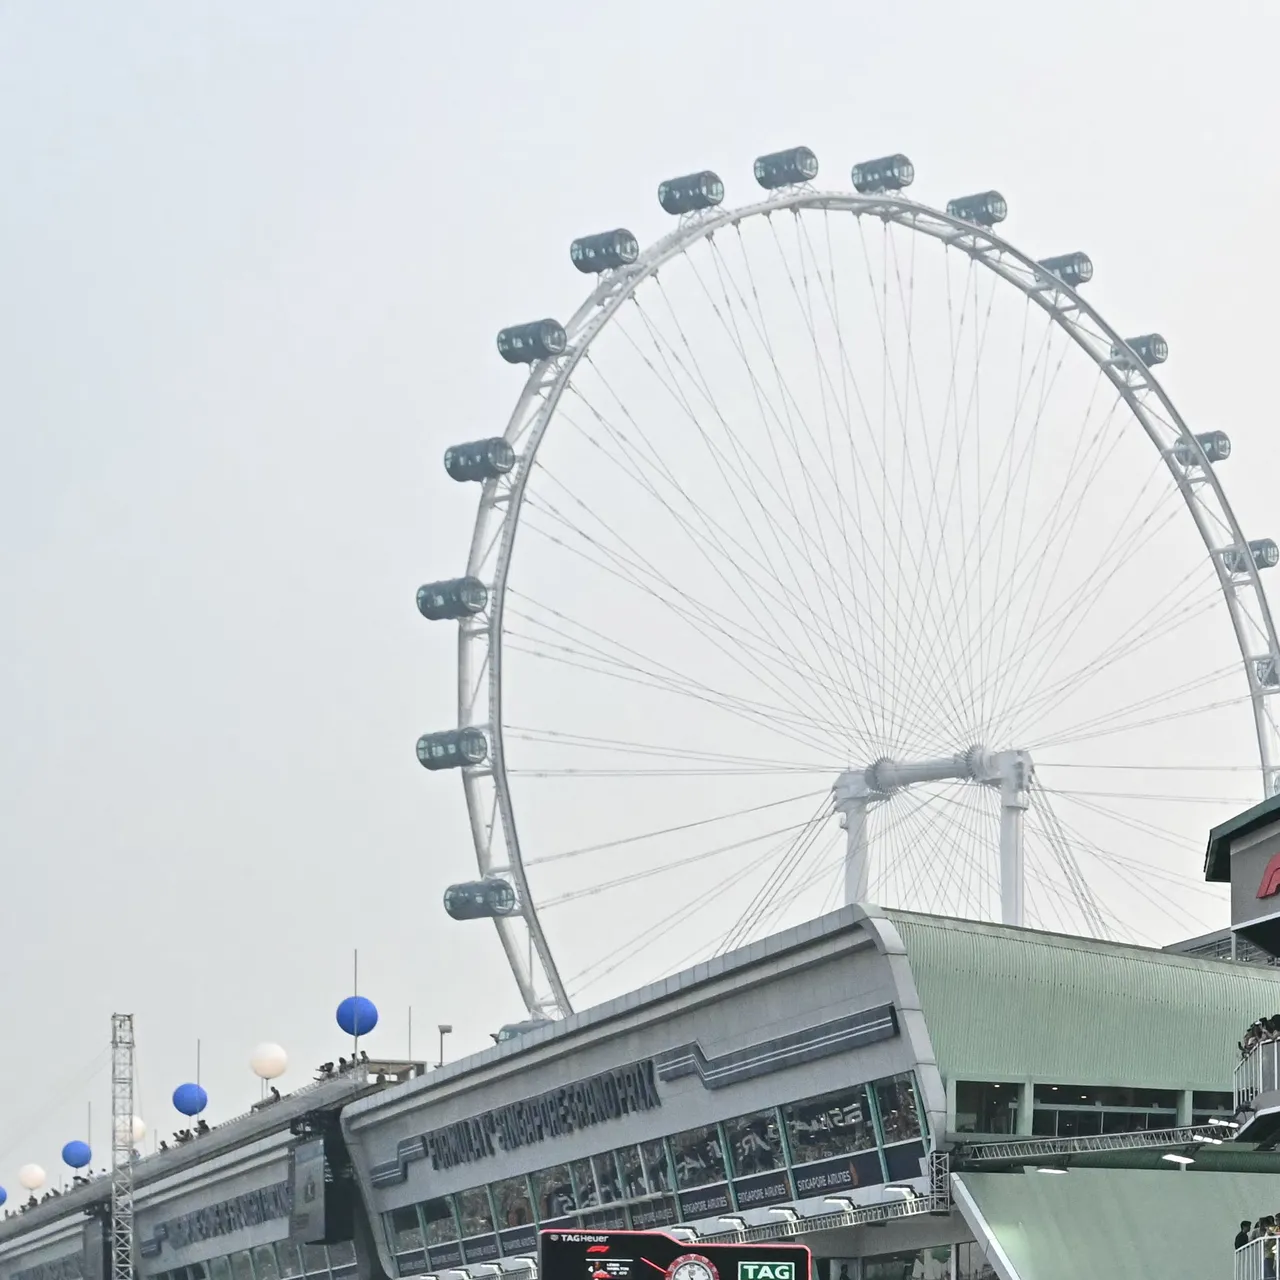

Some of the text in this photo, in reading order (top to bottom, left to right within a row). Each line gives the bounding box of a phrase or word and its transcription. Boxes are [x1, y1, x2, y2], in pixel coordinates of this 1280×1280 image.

[797, 1170, 852, 1192] SINGAPORE AIRLINES
[743, 1265, 790, 1280] TAG
